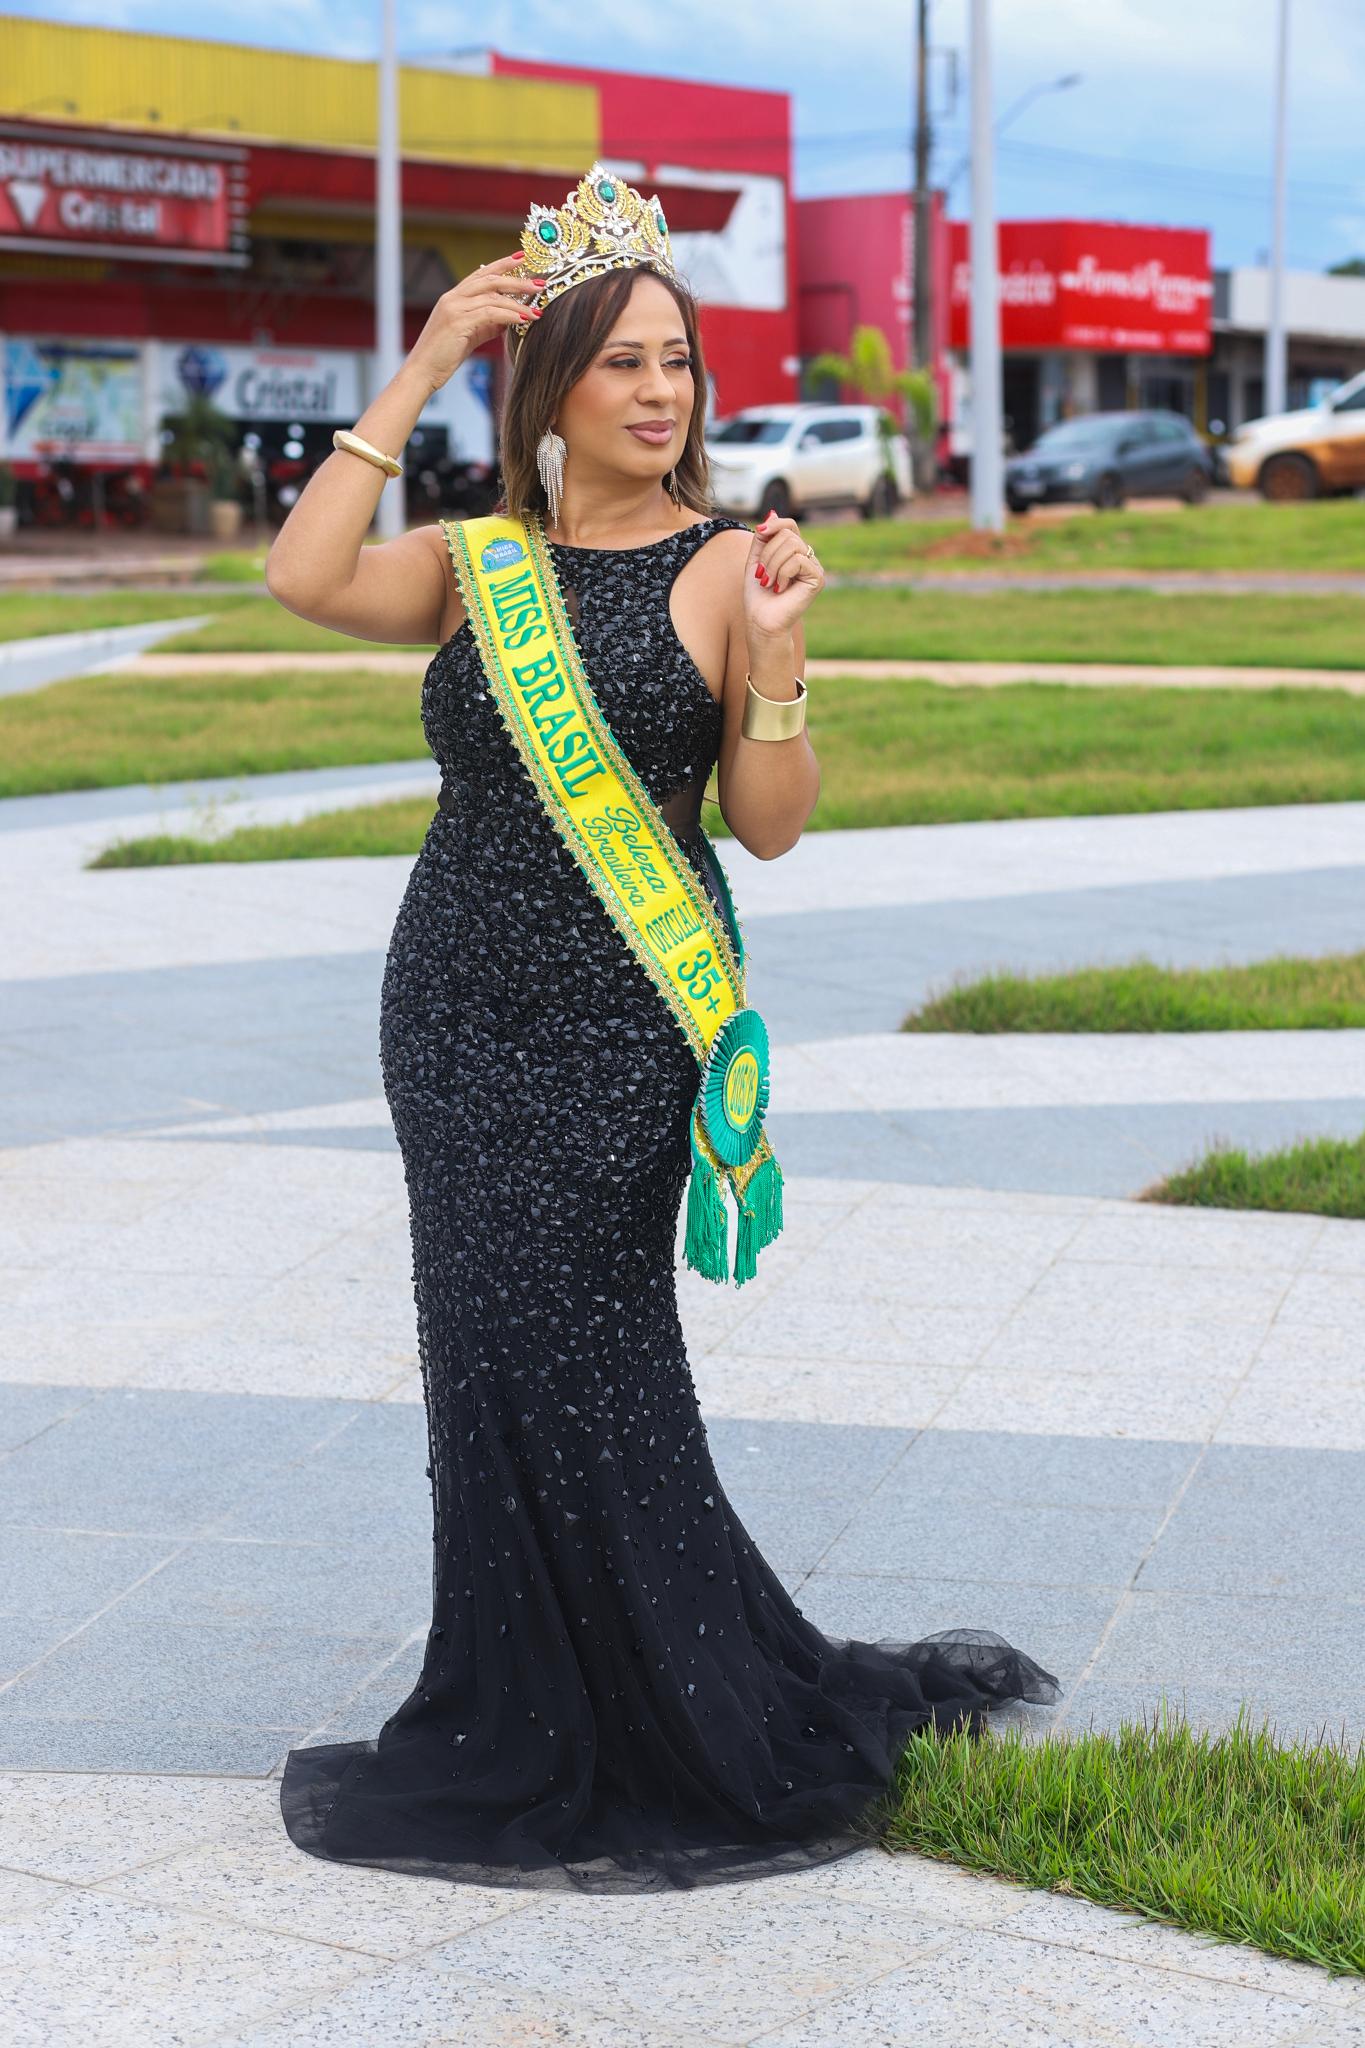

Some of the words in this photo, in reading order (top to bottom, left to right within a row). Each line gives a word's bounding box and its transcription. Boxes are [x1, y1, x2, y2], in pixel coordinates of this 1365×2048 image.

[235, 367, 337, 411] Cristal
[488, 569, 547, 650] MISS
[511, 649, 607, 799] BRASIL
[582, 817, 645, 907] Brasileira
[605, 806, 667, 894] Beleza
[645, 900, 701, 954] OFICIAL
[677, 949, 723, 1014] 35+
